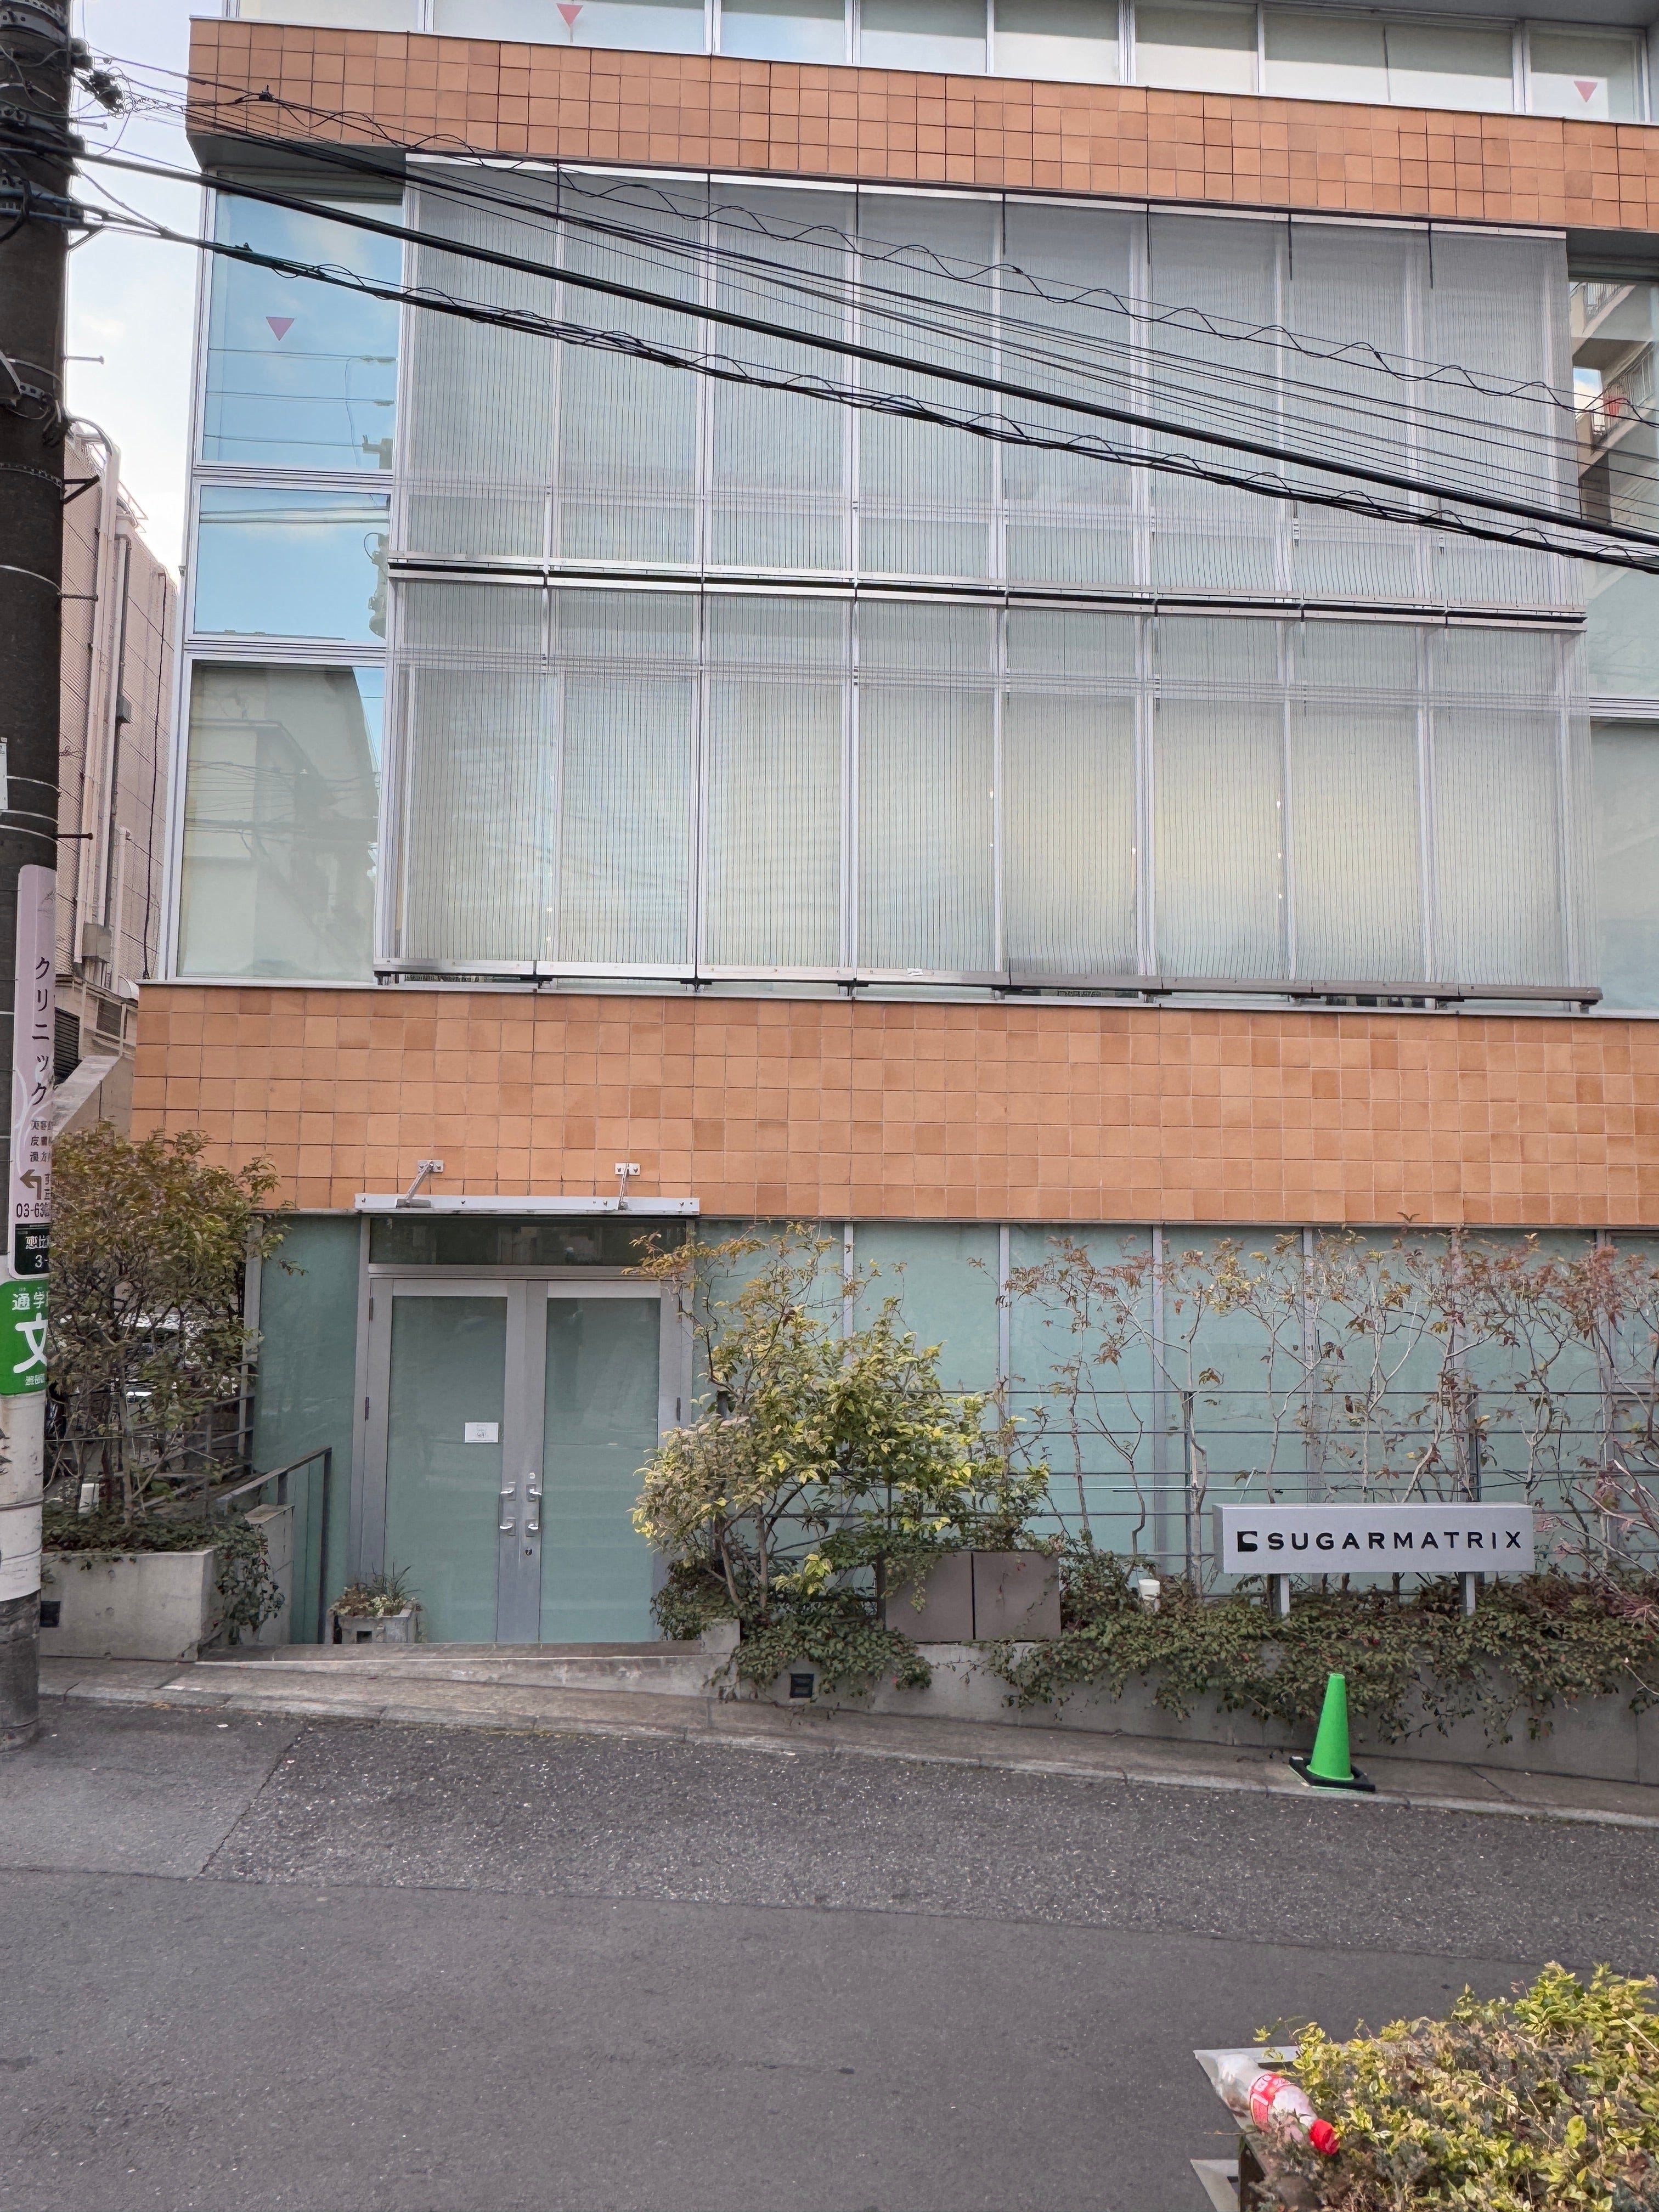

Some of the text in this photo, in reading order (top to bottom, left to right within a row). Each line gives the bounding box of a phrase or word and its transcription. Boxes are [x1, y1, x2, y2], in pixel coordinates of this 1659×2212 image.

[31, 957, 50, 1105] クリニック
[1267, 1531, 1521, 1550] SUGARMATRIX
